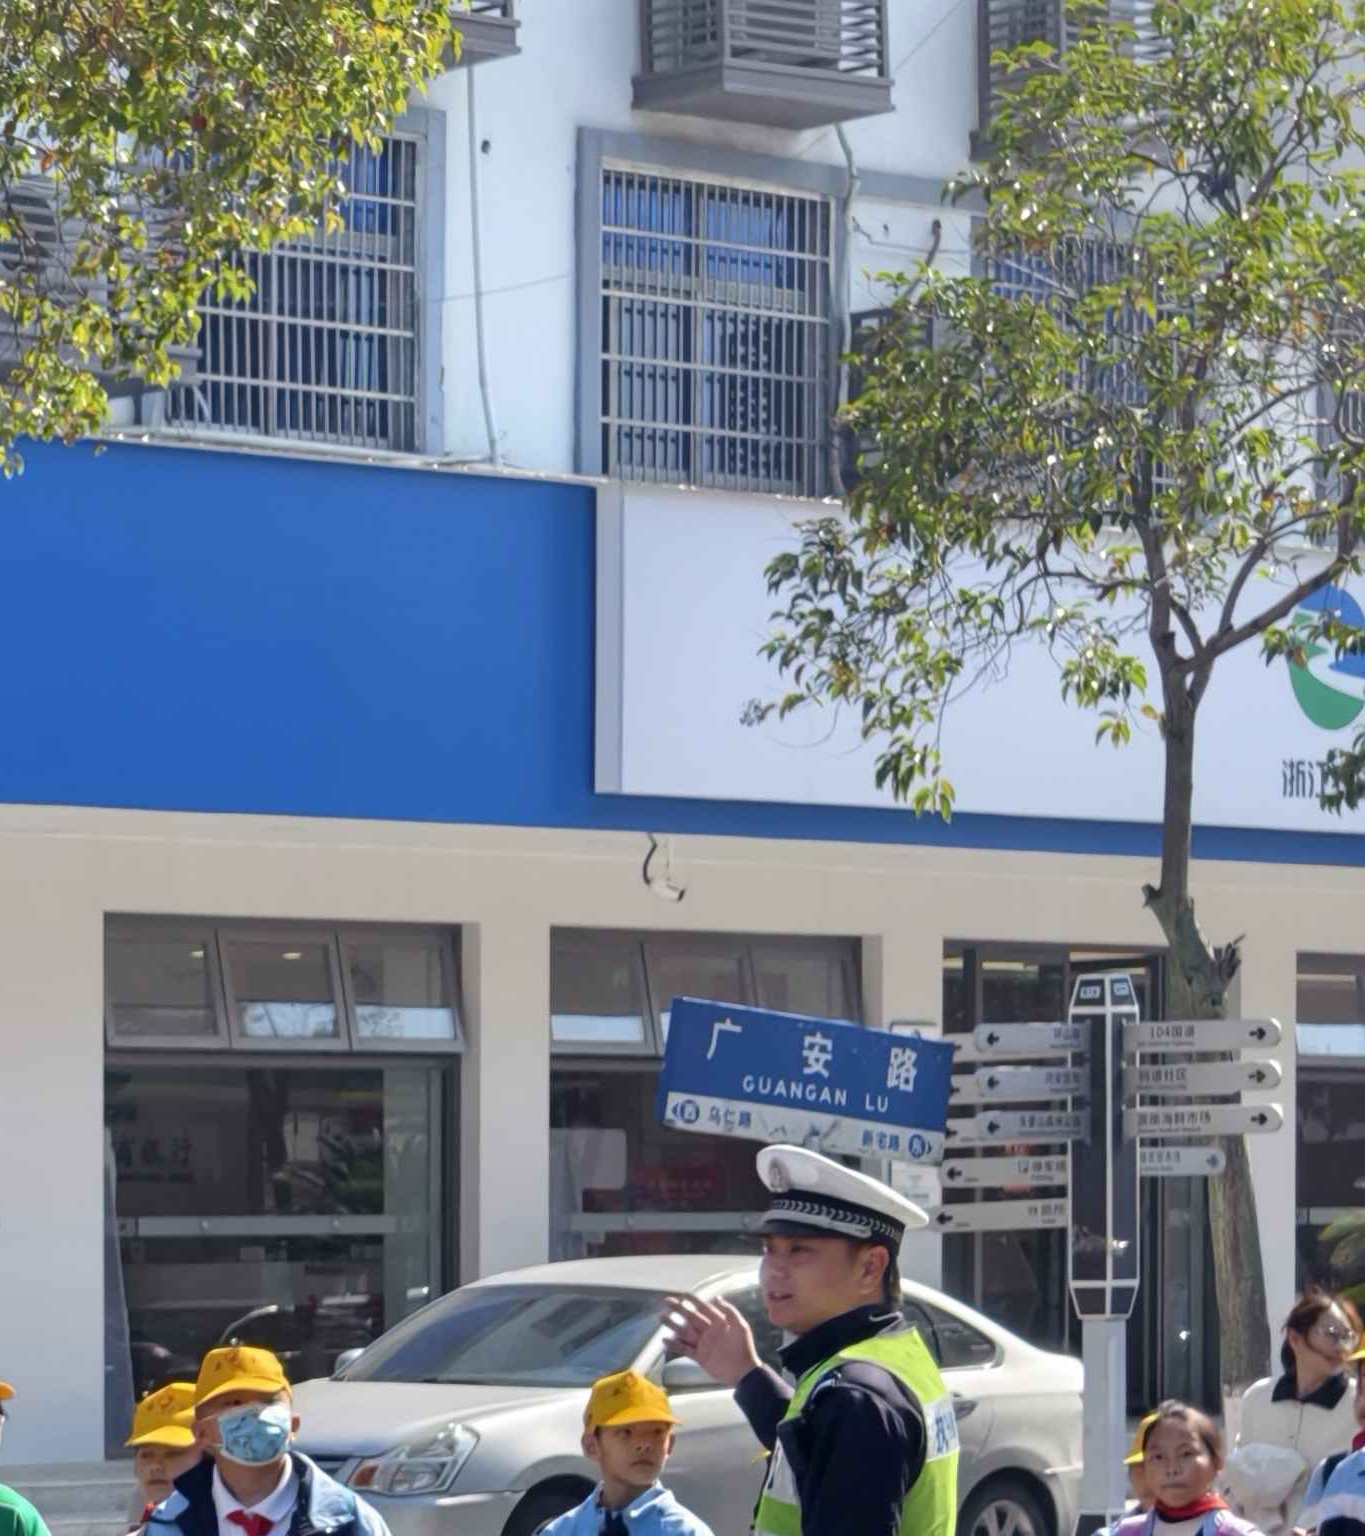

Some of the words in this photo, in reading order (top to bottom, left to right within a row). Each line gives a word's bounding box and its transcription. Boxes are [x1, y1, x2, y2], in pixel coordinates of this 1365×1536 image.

[706, 1016, 918, 1092] 广安路
[742, 1074, 848, 1107] GUANGAN
[864, 1092, 890, 1113] LU
